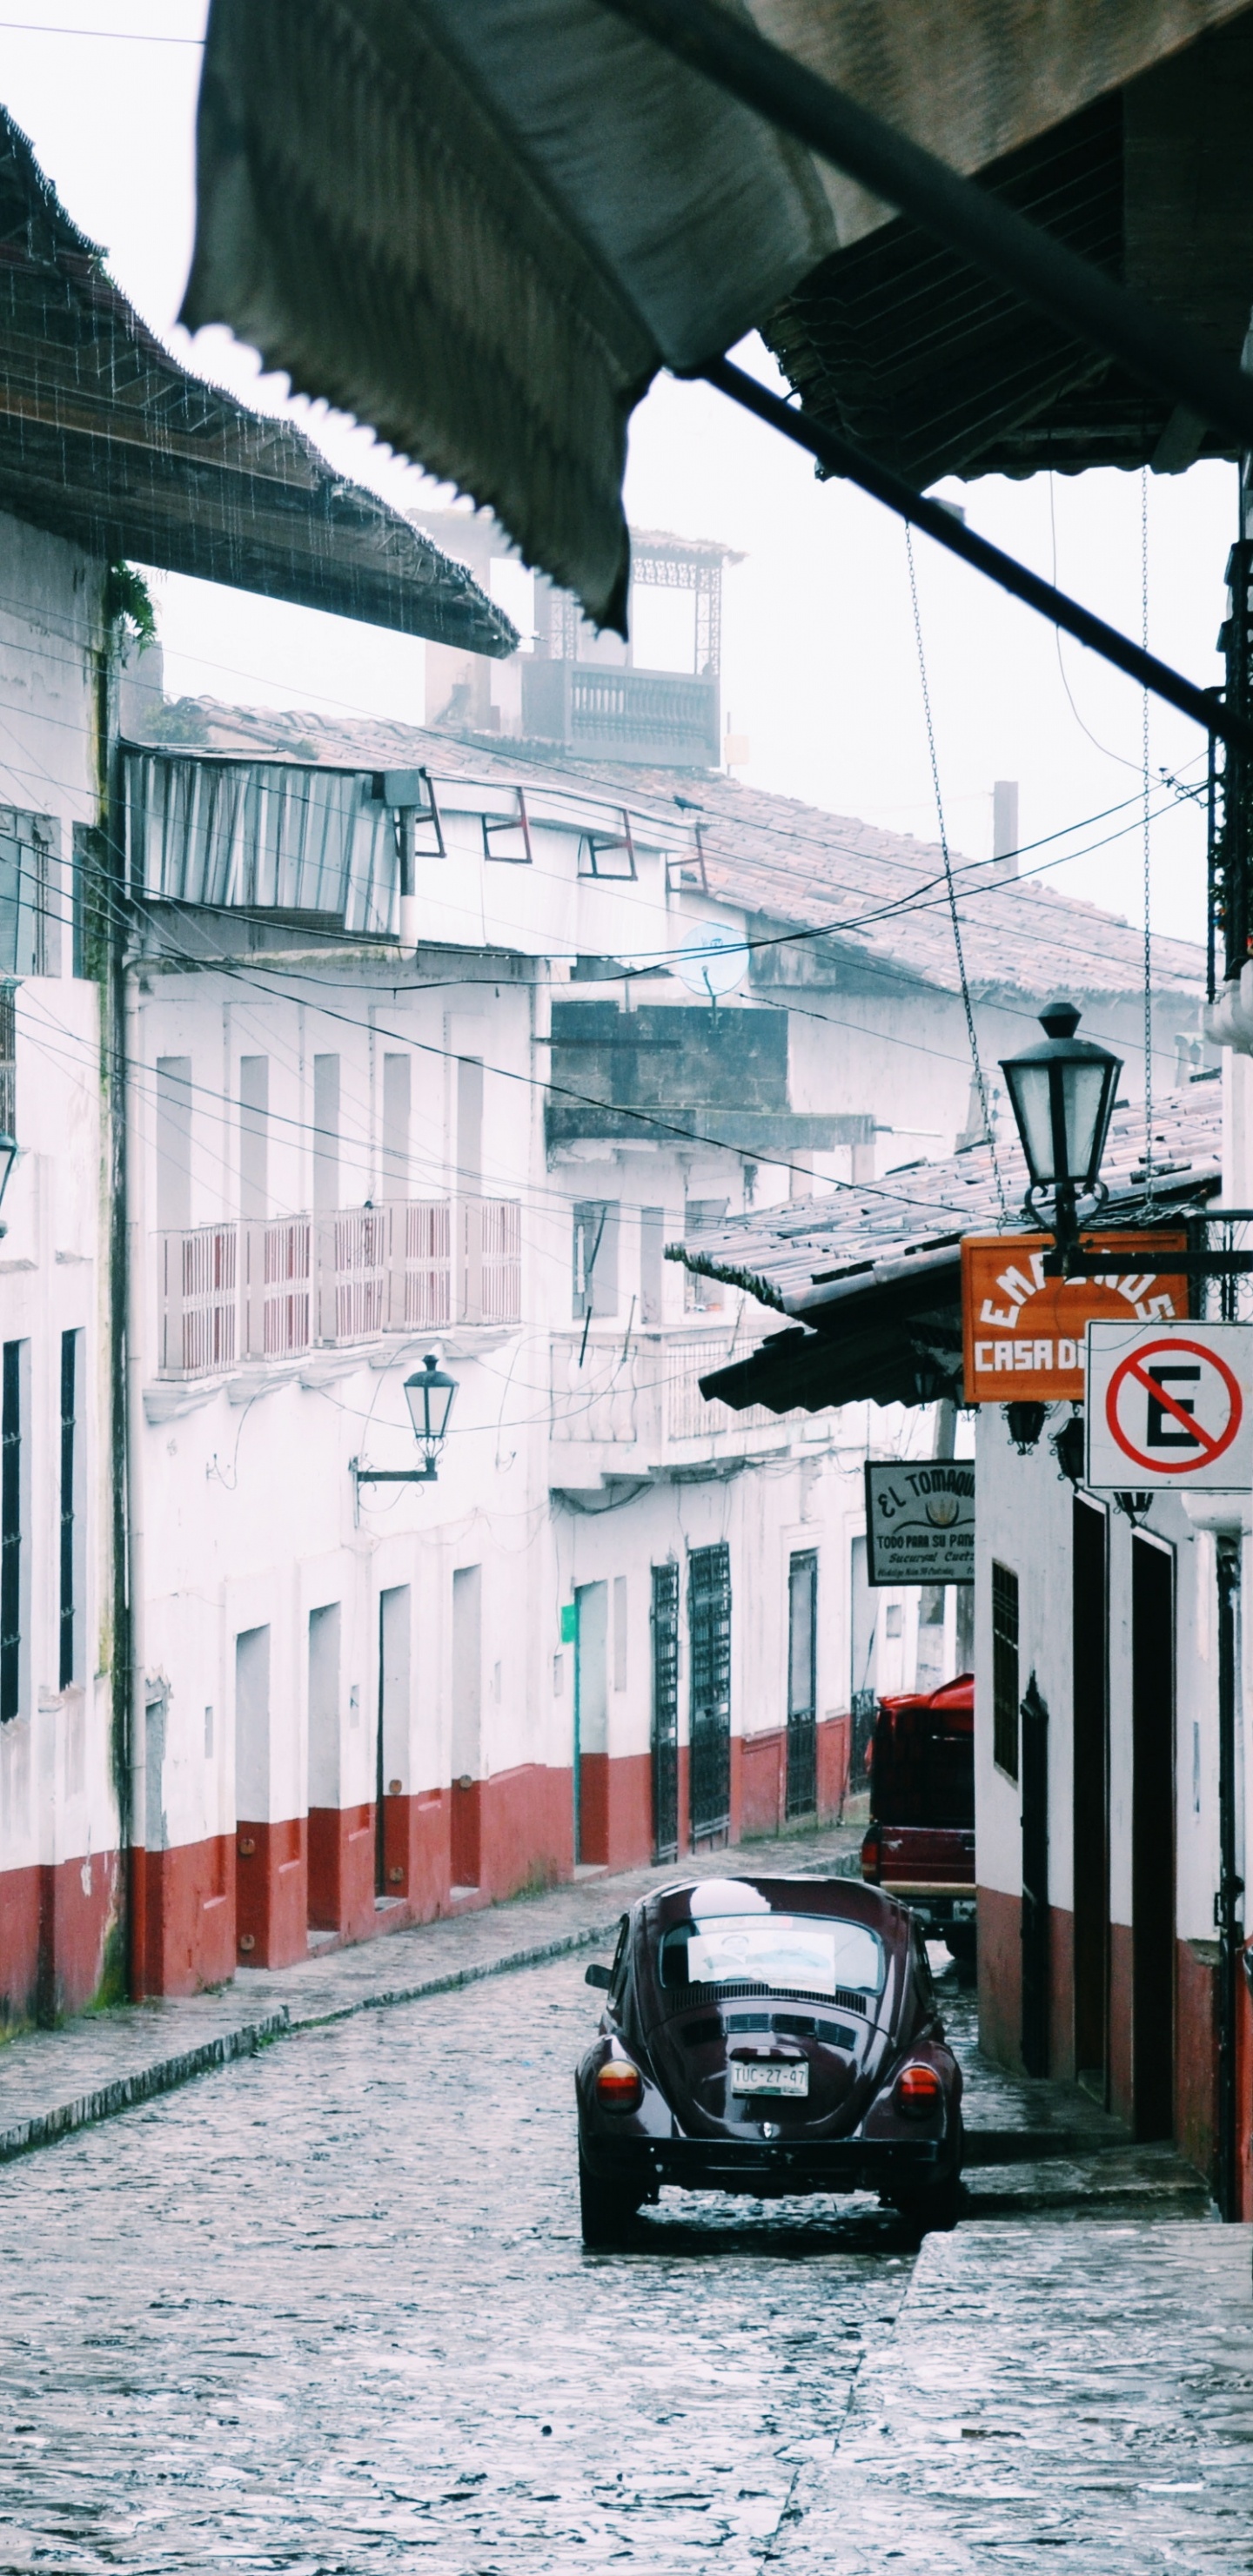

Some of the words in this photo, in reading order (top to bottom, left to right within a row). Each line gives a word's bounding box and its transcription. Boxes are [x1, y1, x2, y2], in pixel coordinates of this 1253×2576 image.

[975, 1339, 1053, 1372] CASA
[1147, 1365, 1201, 1447] E
[878, 1486, 907, 1518] EL
[877, 1535, 904, 1549] TODO
[906, 1535, 929, 1548] PARA
[933, 1534, 946, 1547] SU
[889, 1552, 938, 1563] Sucursal
